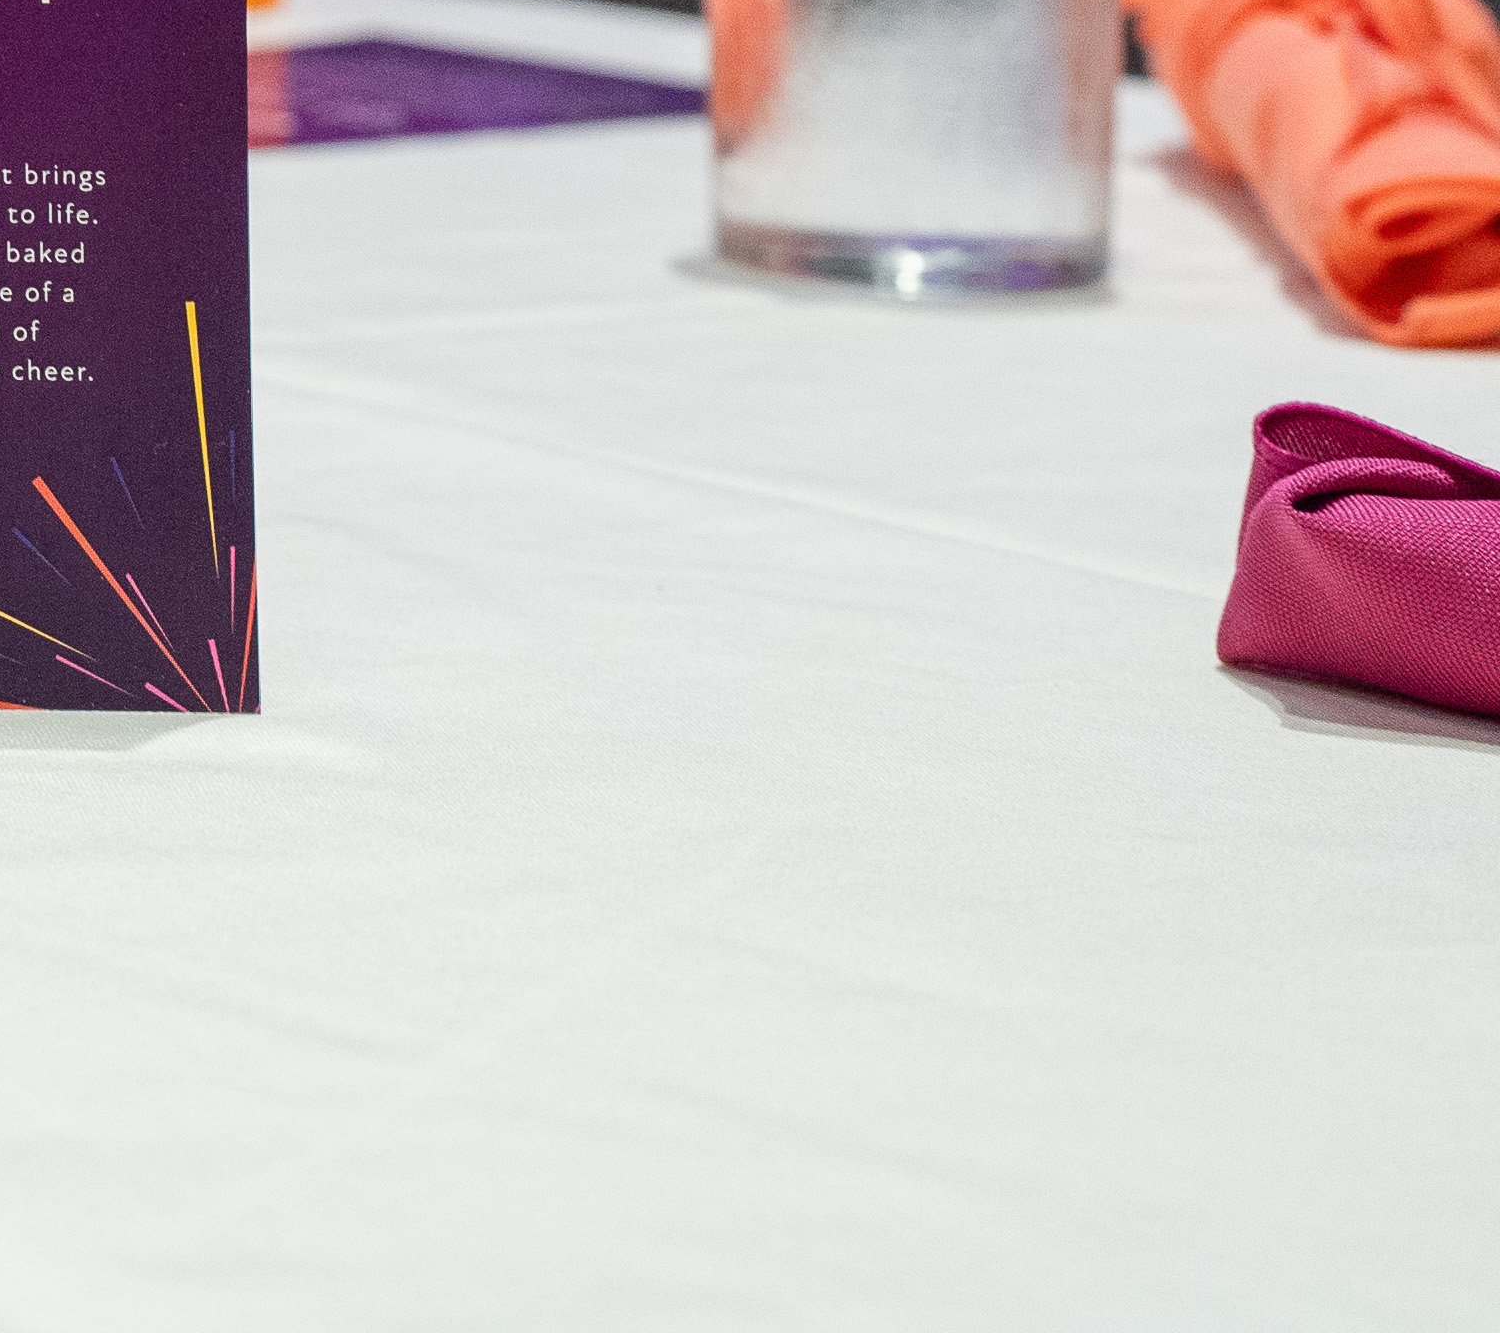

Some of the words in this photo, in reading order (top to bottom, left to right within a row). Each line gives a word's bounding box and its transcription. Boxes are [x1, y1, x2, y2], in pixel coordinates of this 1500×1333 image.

[24, 162, 106, 193] brings
[7, 207, 36, 225] to
[48, 202, 98, 225] life.
[6, 240, 85, 264] baked
[24, 280, 53, 303] of
[62, 287, 75, 303] a
[12, 319, 40, 342] of
[11, 358, 94, 382] cheer.
